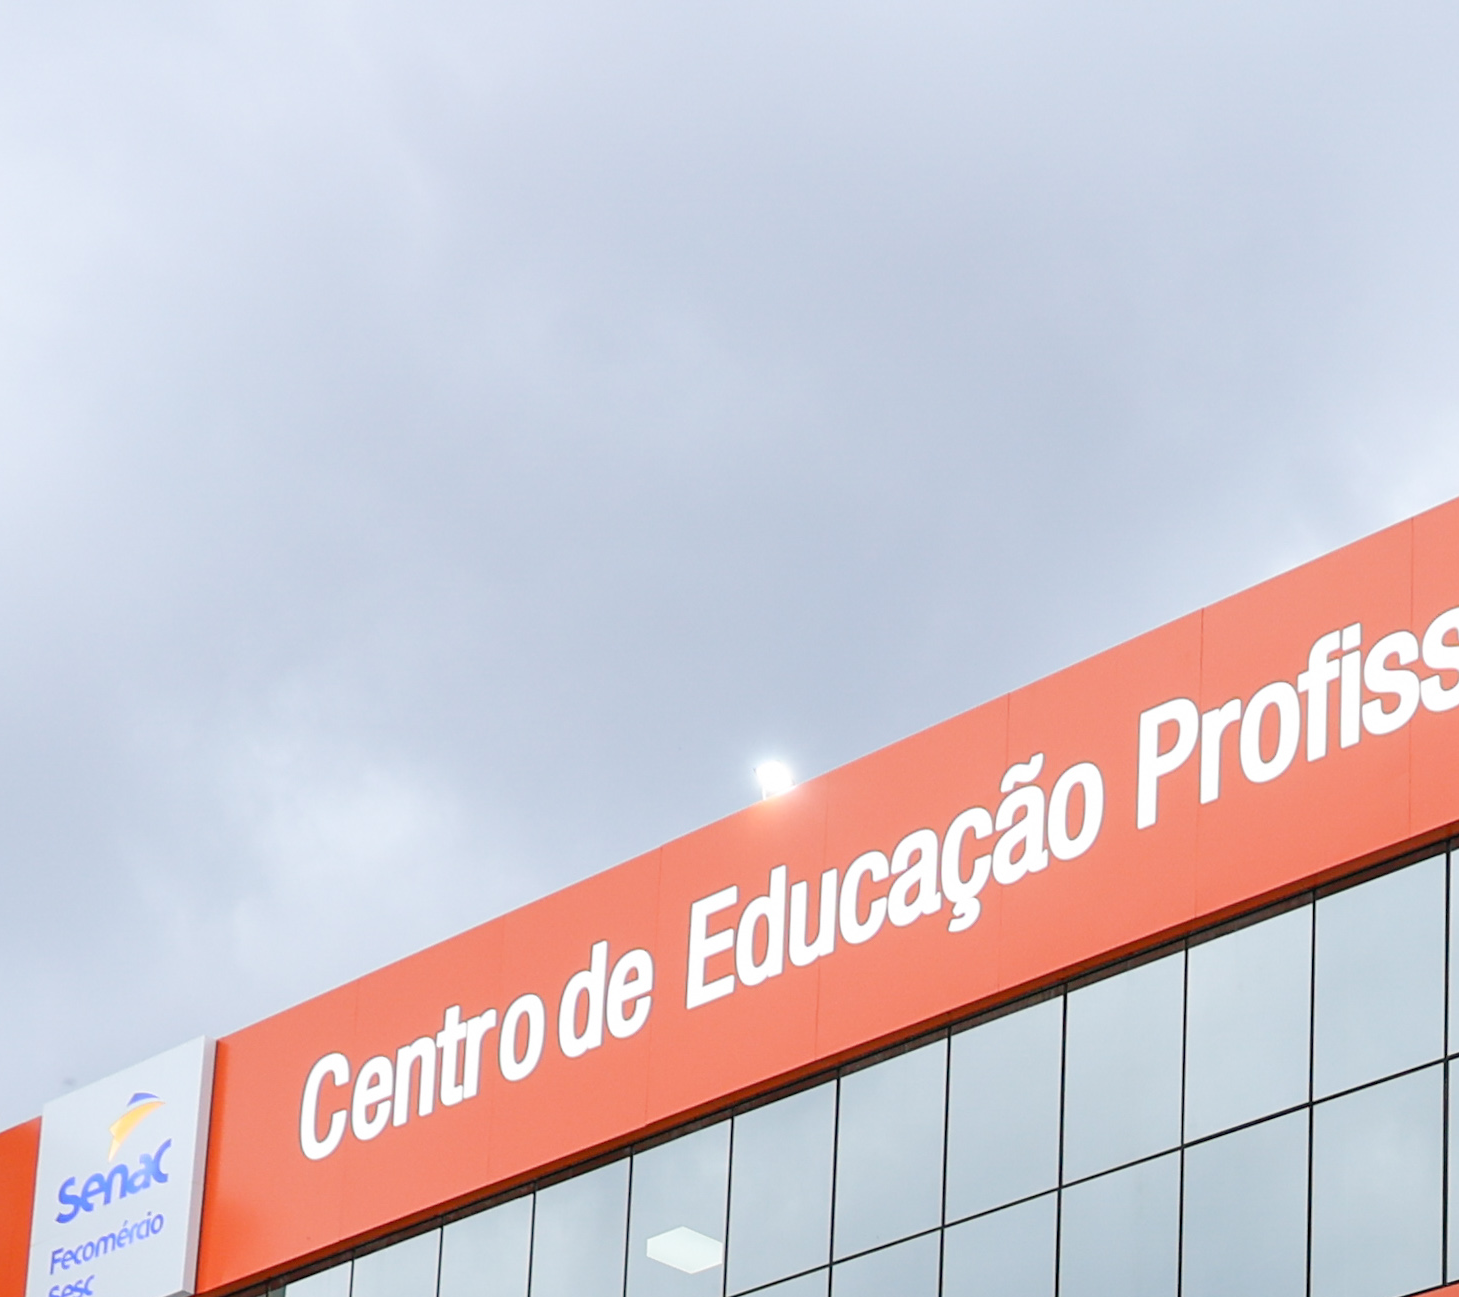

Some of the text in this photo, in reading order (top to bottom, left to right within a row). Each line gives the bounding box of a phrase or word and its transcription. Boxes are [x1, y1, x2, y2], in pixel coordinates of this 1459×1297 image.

[299, 993, 545, 1161] Centro
[557, 939, 654, 1059] de
[685, 752, 1105, 1010] Educação
[49, 1211, 165, 1276] Fecomércio
